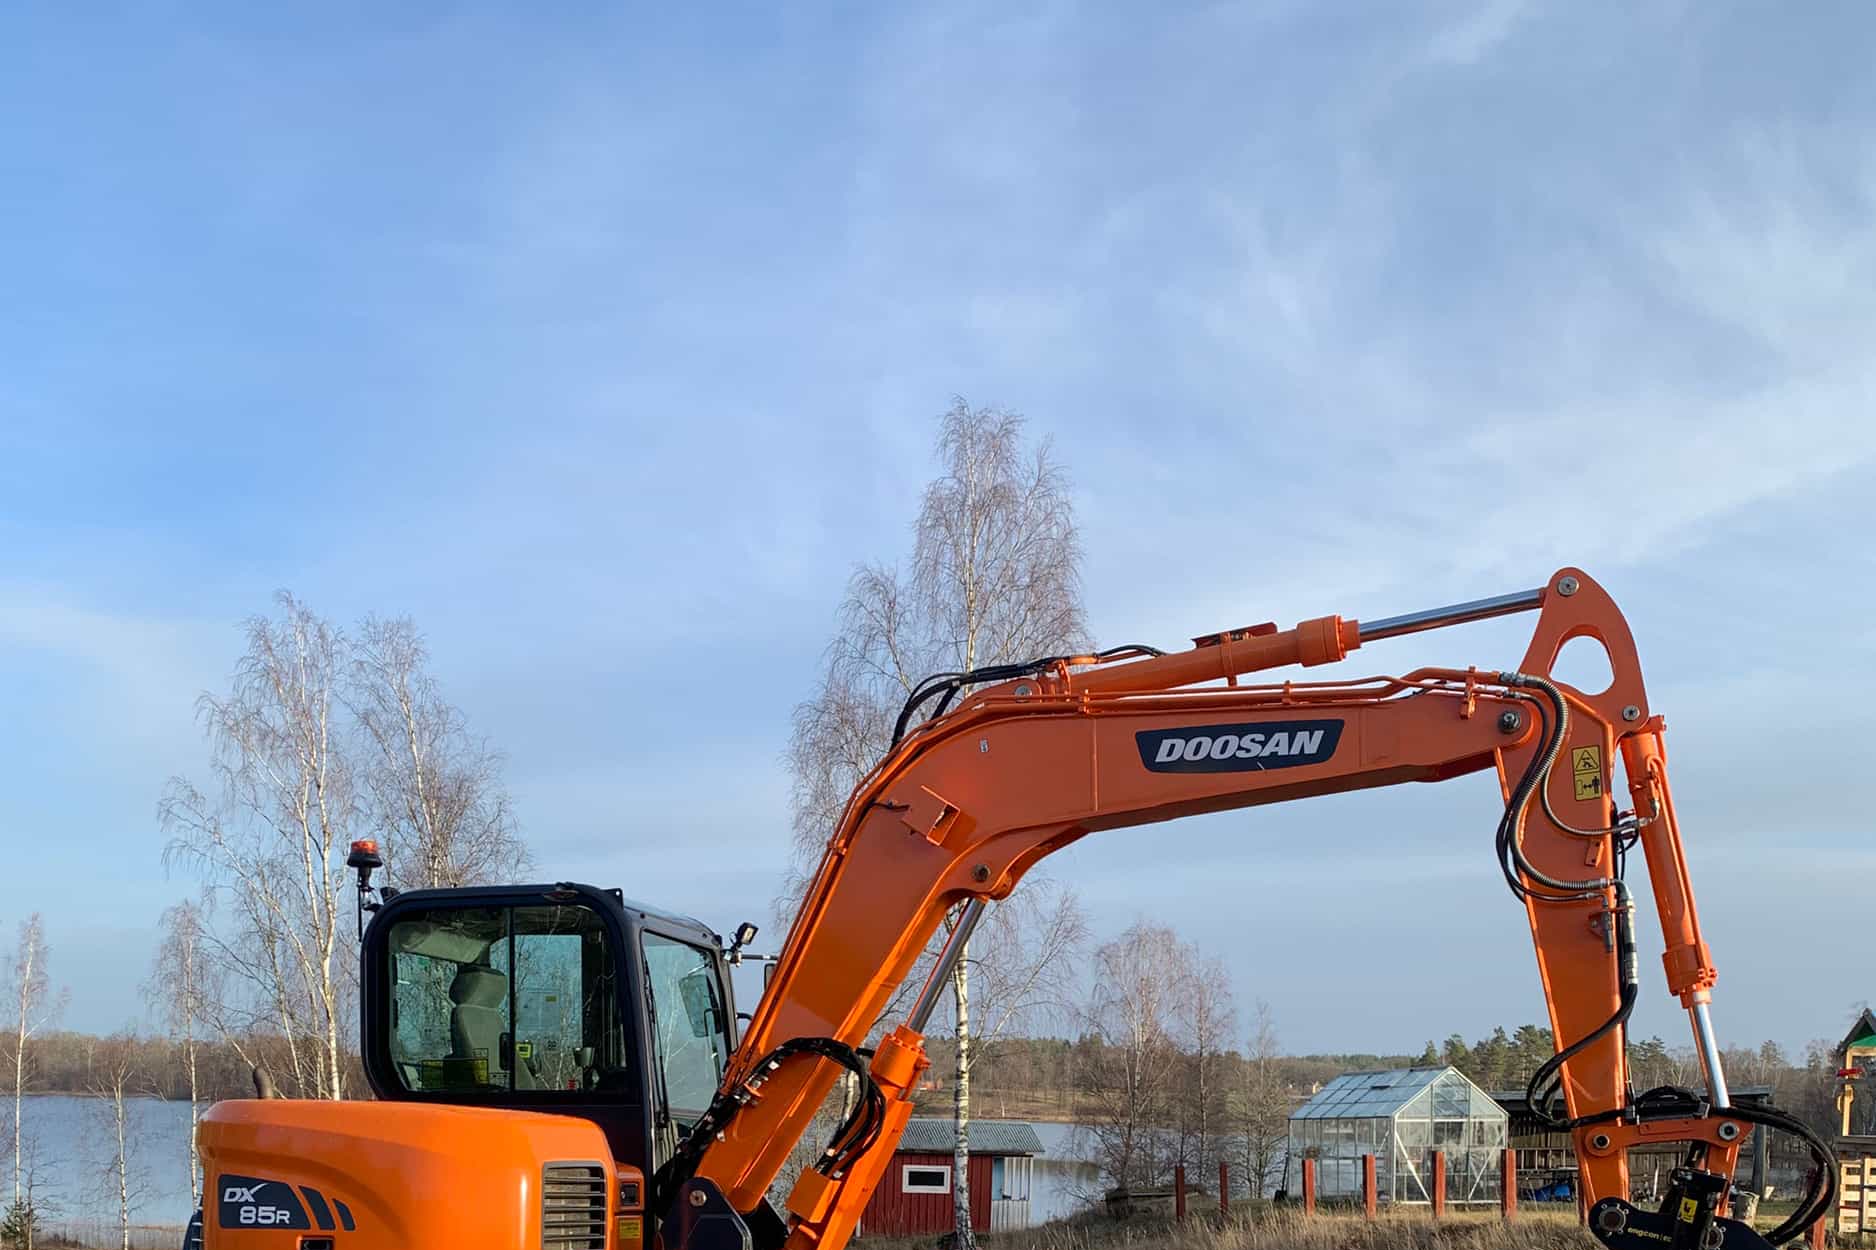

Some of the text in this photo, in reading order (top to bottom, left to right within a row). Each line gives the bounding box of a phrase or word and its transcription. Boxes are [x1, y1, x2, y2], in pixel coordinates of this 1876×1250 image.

[1154, 730, 1325, 763] DOOSAN
[224, 1183, 266, 1202] DX
[240, 1206, 290, 1223] 85R
